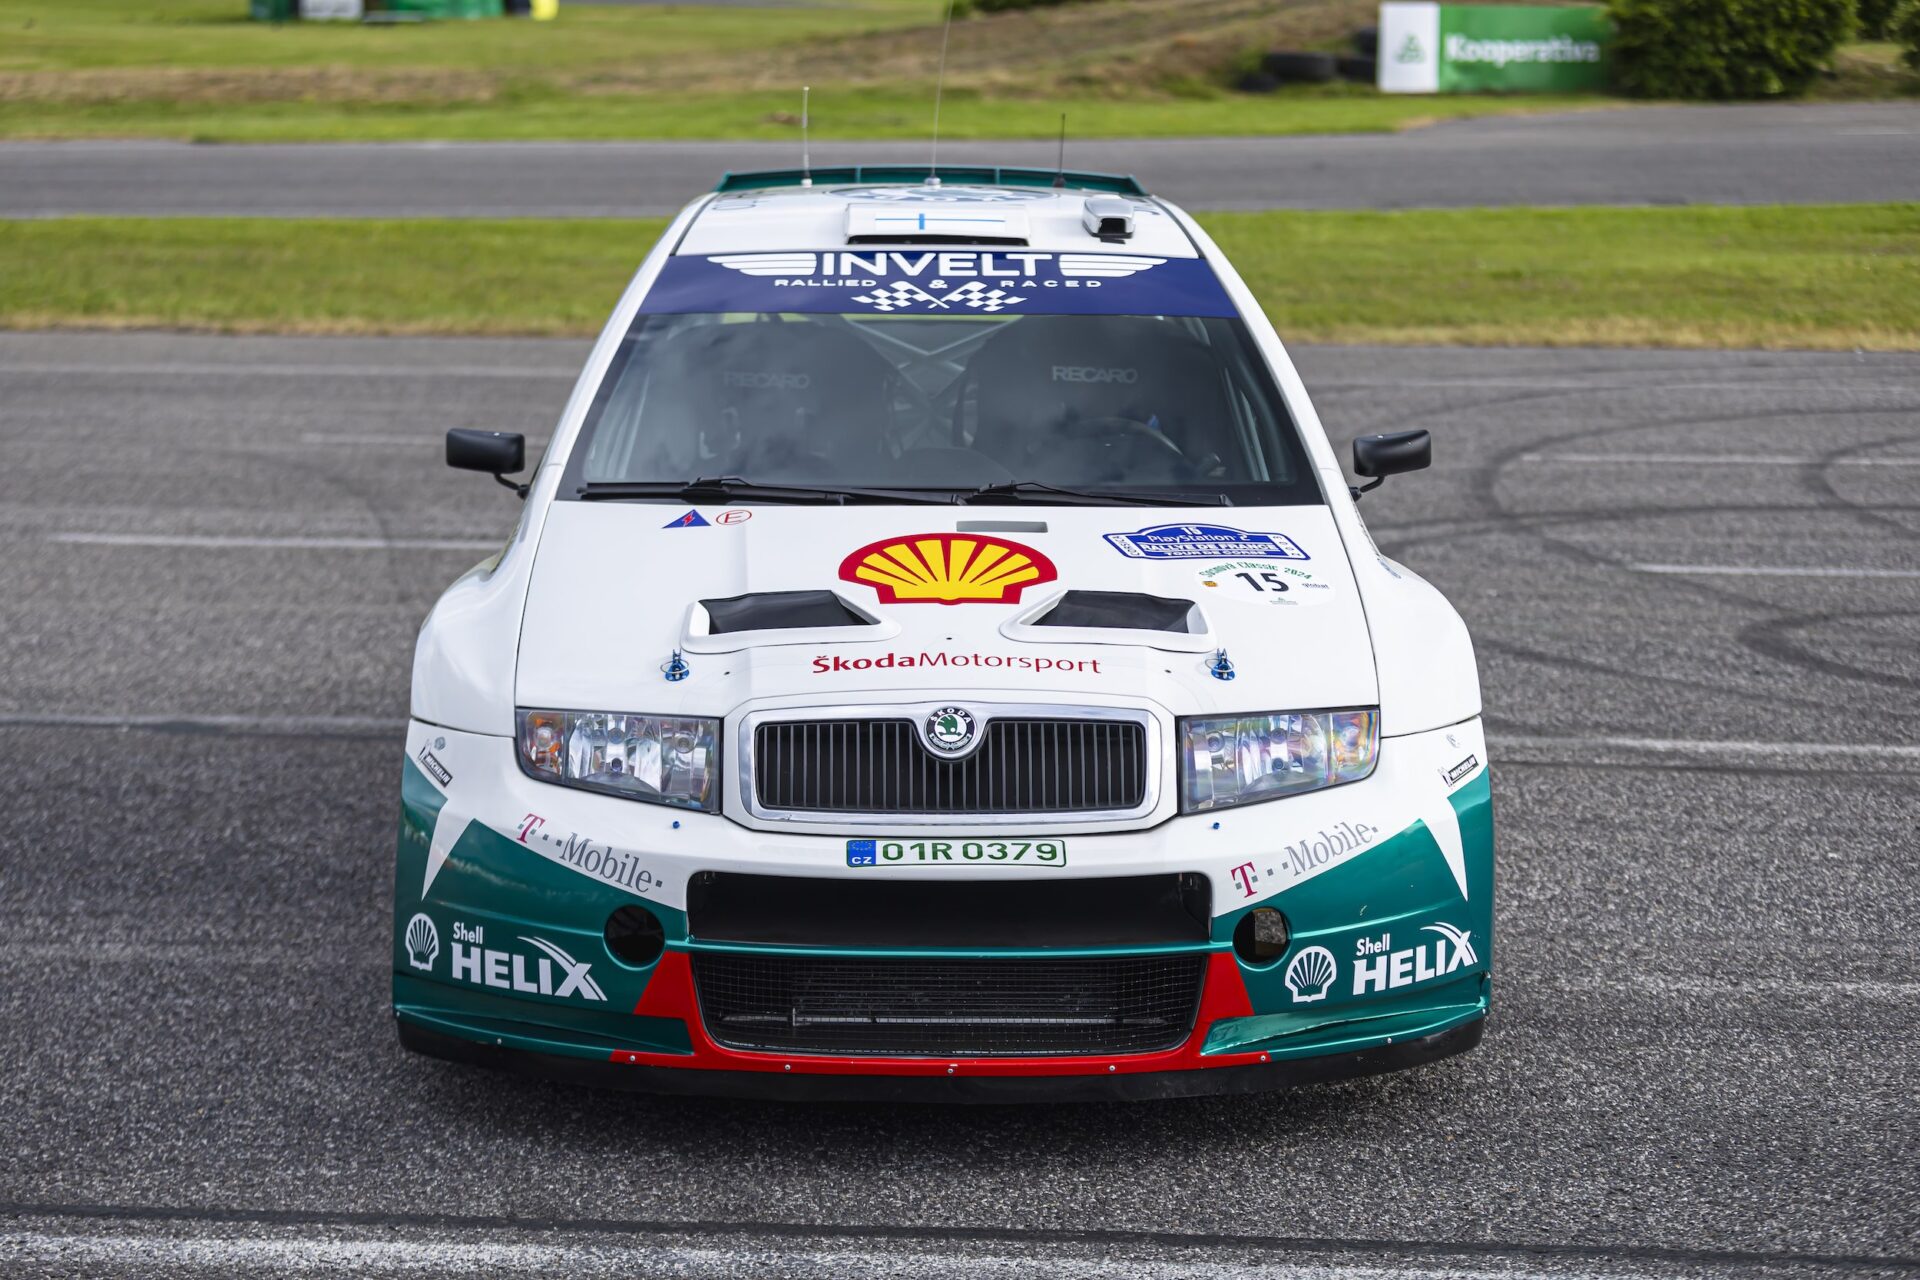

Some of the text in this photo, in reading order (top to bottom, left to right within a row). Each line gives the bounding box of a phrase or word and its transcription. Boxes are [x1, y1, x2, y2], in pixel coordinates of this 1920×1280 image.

[1445, 34, 1599, 68] Kooperativa
[822, 252, 1053, 276] INVELT
[774, 278, 1102, 289] RALLIED & RACED
[723, 371, 810, 389] RECARO
[1051, 365, 1139, 384] RECARO
[1147, 533, 1252, 543] PlayStation 2
[1180, 526, 1203, 535] 15
[1140, 543, 1195, 551] RALLYE
[1237, 561, 1279, 571] Classic
[1283, 567, 1314, 580] 2024
[1234, 572, 1290, 592] 15
[423, 753, 451, 784] MICHELIN
[1450, 756, 1477, 780] MICHELIN
[851, 856, 872, 865] CZ
[962, 842, 1058, 861] 0379
[452, 921, 484, 944] Shell
[1355, 933, 1391, 956] Shell
[450, 935, 608, 1002] HELIX
[1352, 922, 1478, 996] HELIX
